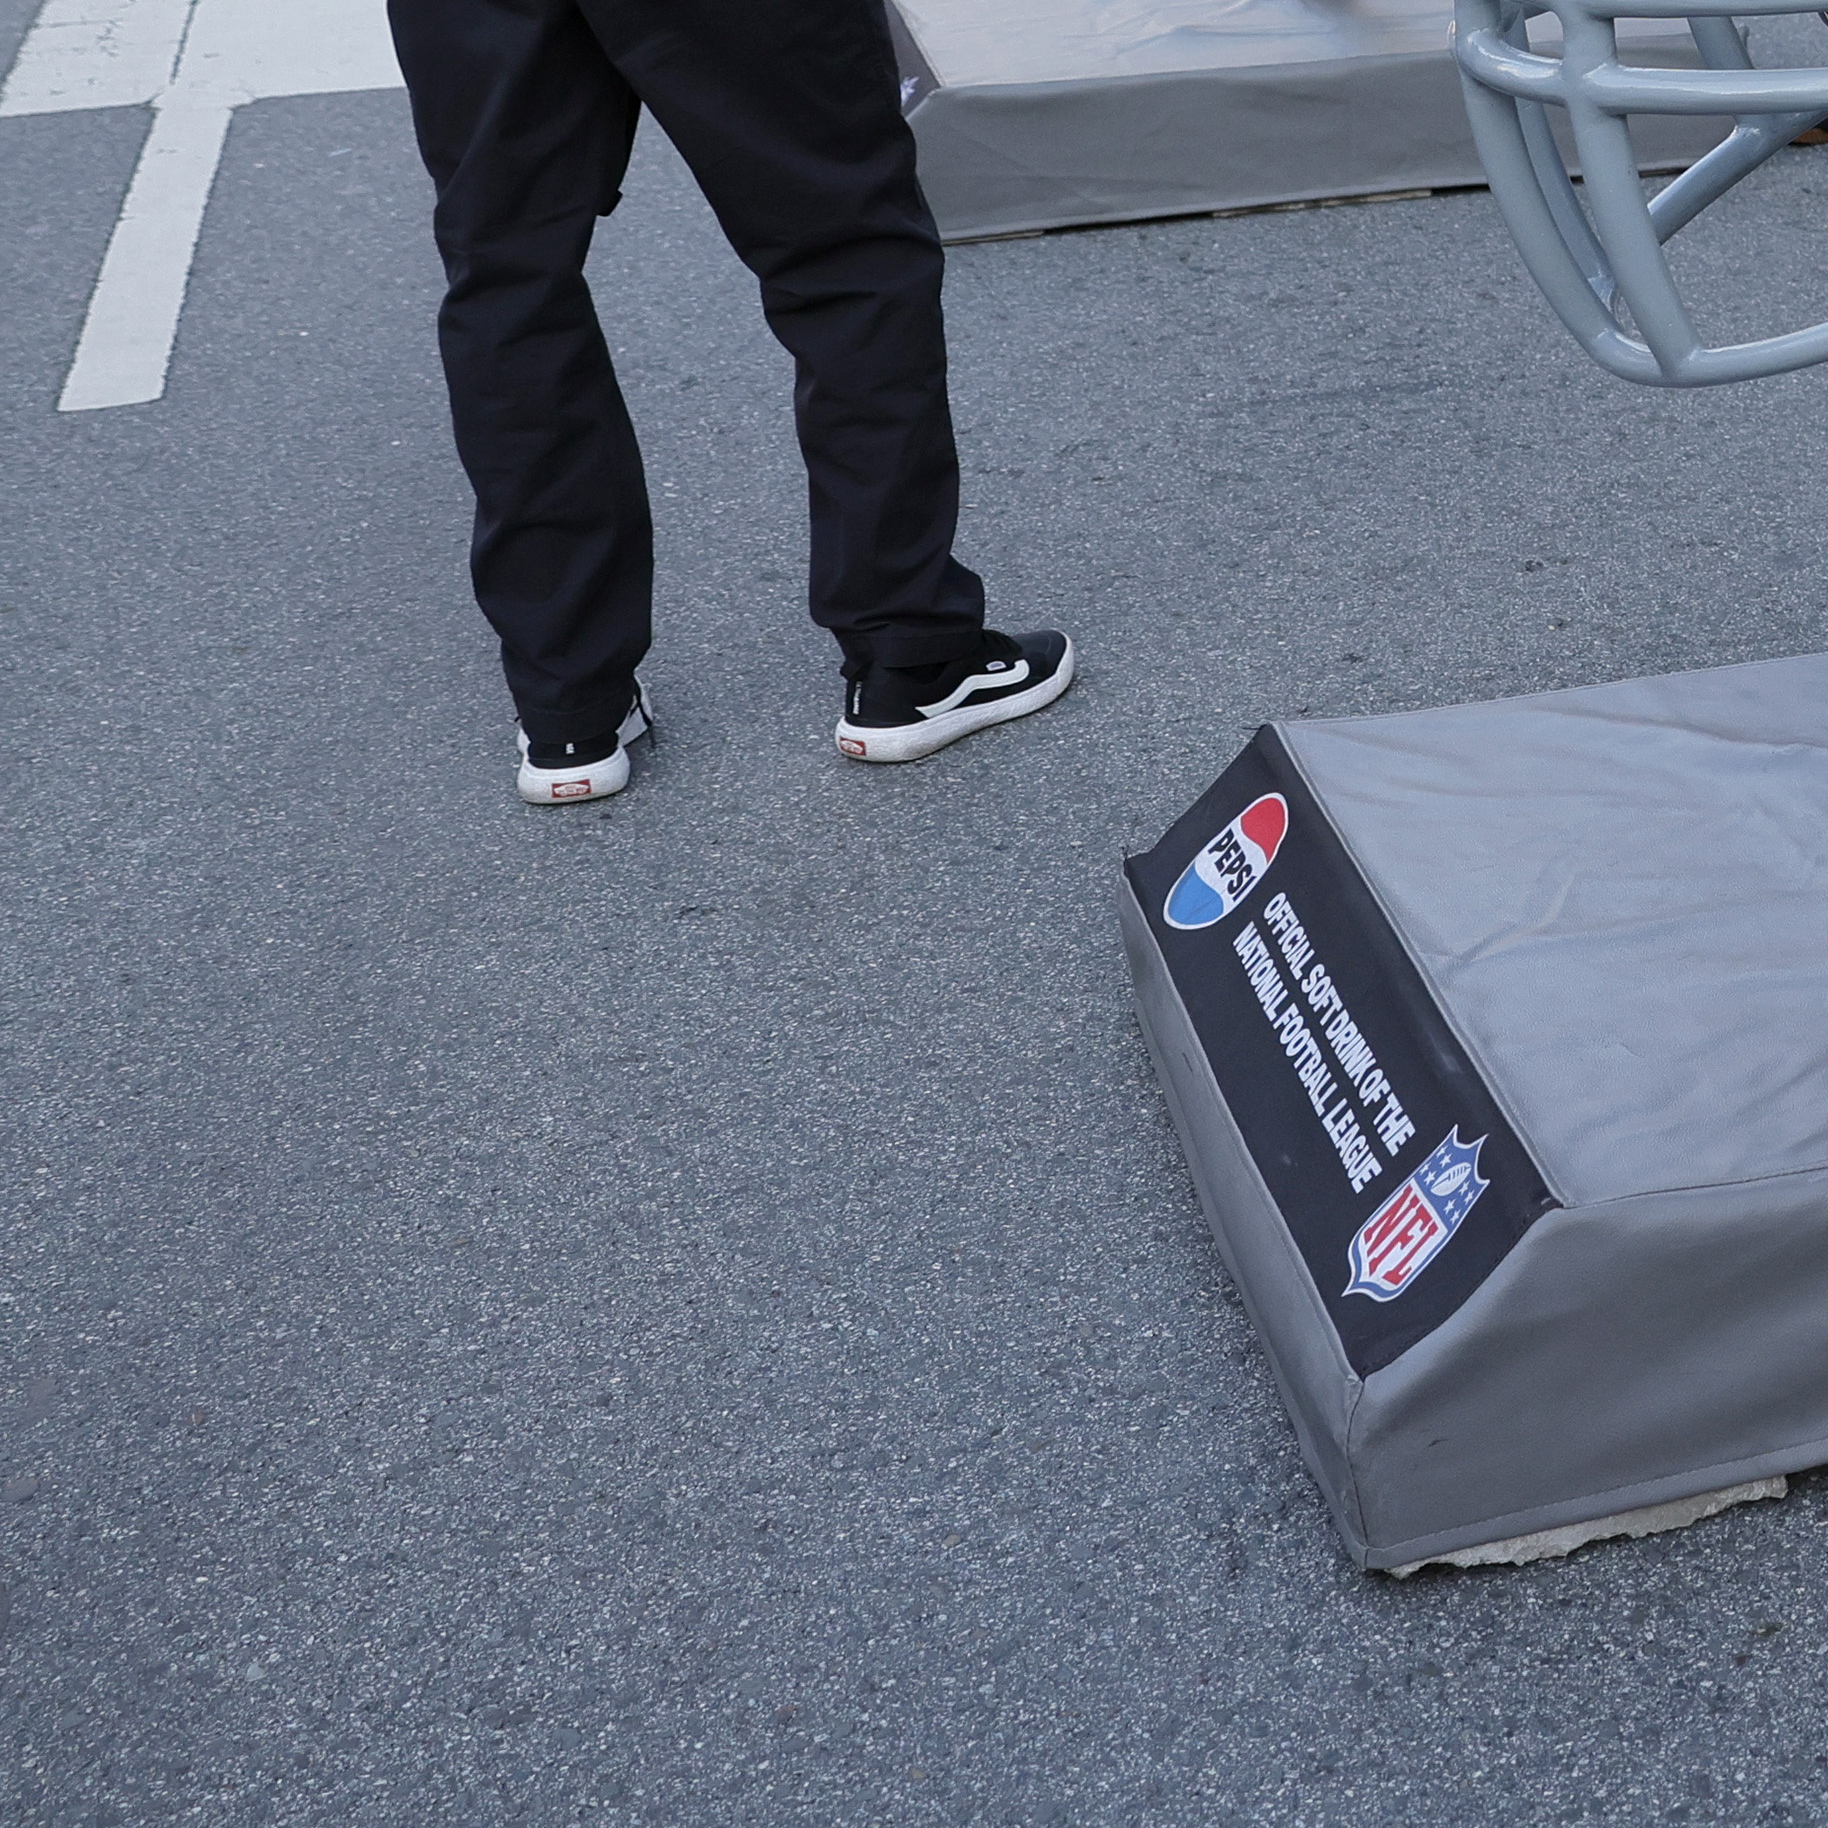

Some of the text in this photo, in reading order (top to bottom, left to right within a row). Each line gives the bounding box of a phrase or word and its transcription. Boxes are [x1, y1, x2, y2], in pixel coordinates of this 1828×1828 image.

[1207, 828, 1257, 902] PEPSI
[1233, 921, 1383, 1194] NATIONAL FOOTBALL LEAGUE
[1263, 892, 1416, 1157] OFFICIAL SOFT DRINK OF THE
[1363, 1183, 1439, 1286] NFL
